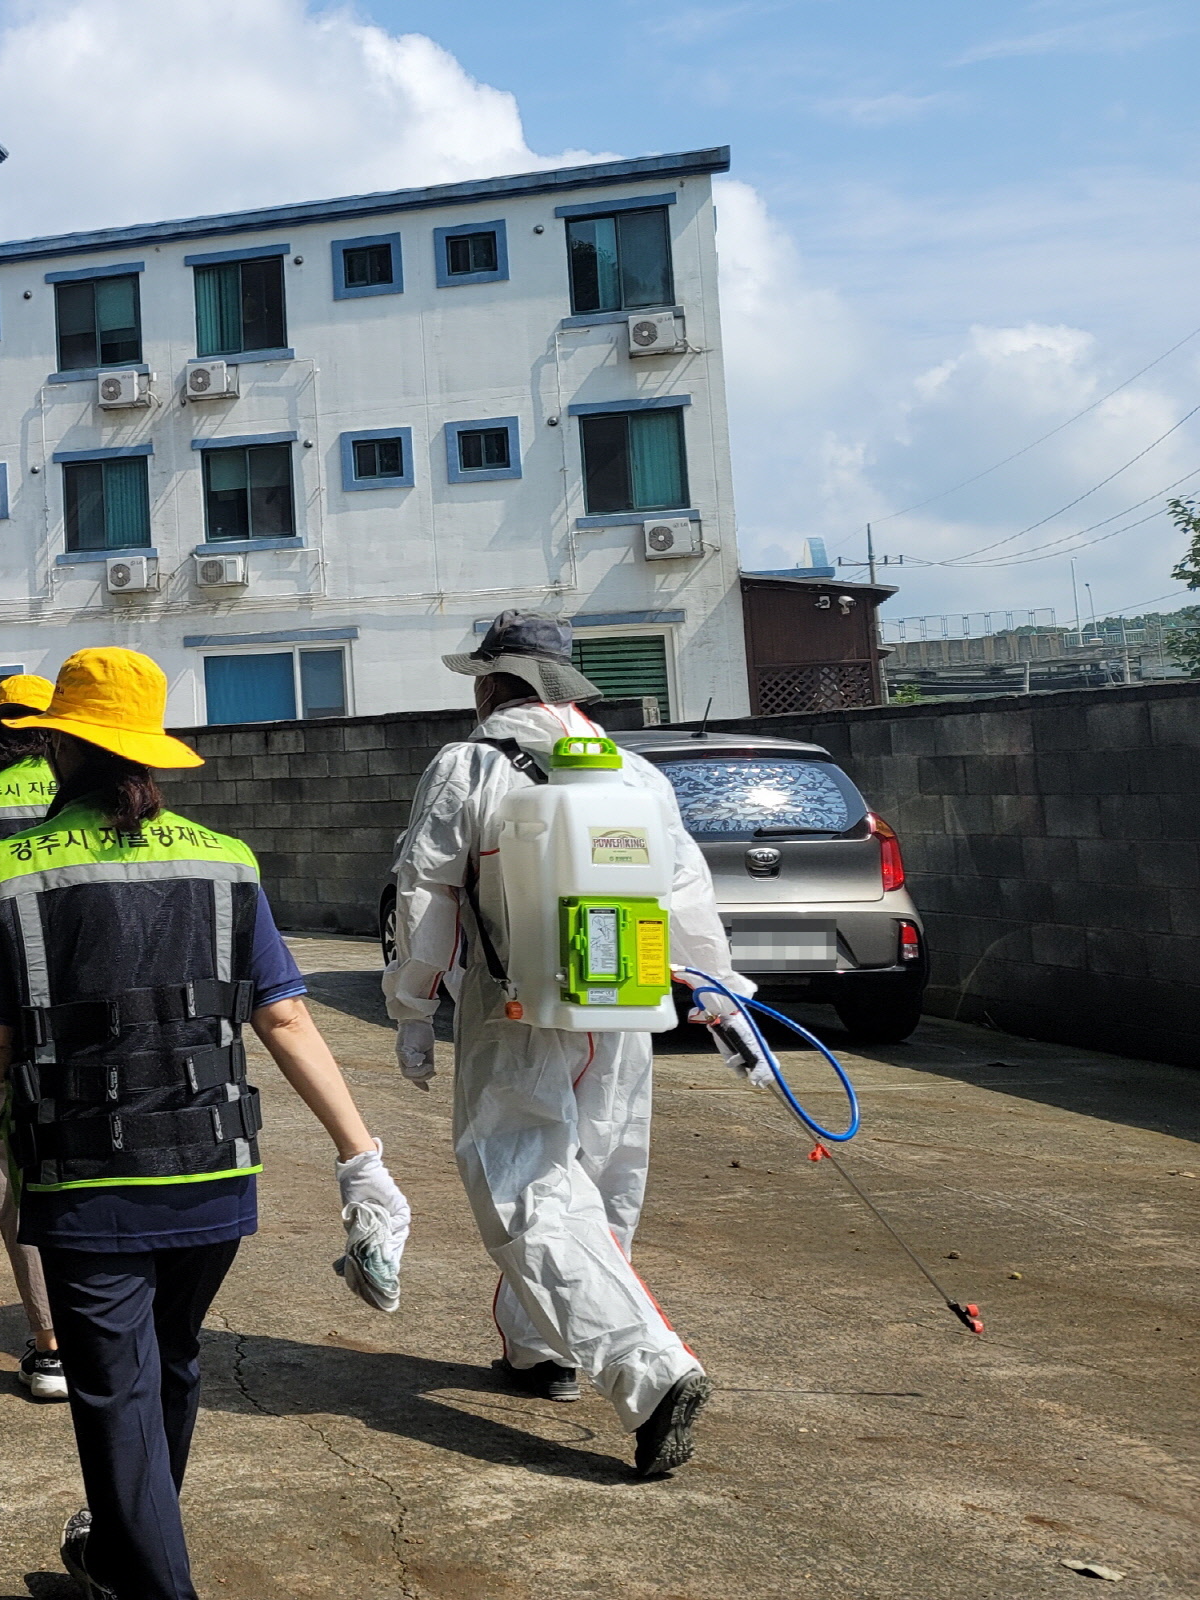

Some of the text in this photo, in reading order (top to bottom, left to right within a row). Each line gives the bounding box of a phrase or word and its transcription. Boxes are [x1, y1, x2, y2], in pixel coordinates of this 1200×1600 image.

[10, 825, 223, 861] 경주시 자율방재단
[593, 837, 646, 848] POWER KING
[756, 852, 774, 861] KIA
